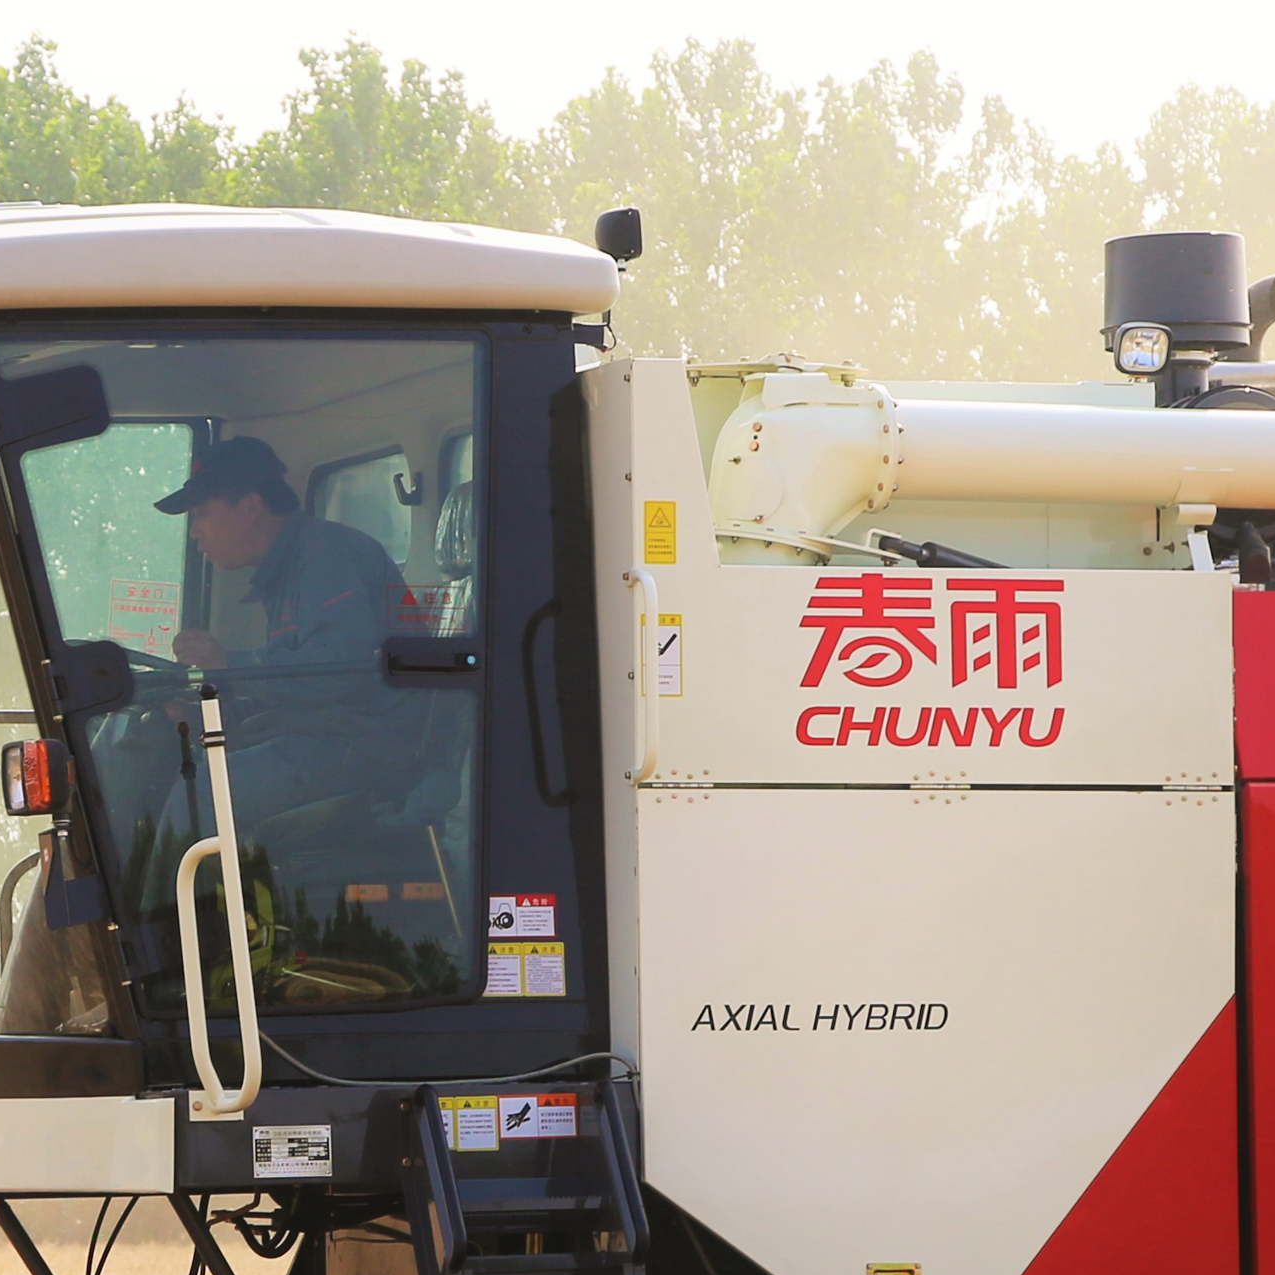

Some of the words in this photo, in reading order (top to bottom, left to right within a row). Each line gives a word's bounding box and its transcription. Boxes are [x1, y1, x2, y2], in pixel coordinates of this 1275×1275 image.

[799, 573, 1064, 689] 春雨
[796, 706, 1065, 747] CHUNYU
[691, 1004, 800, 1031] AXIAL
[812, 1003, 949, 1031] HYBRID
